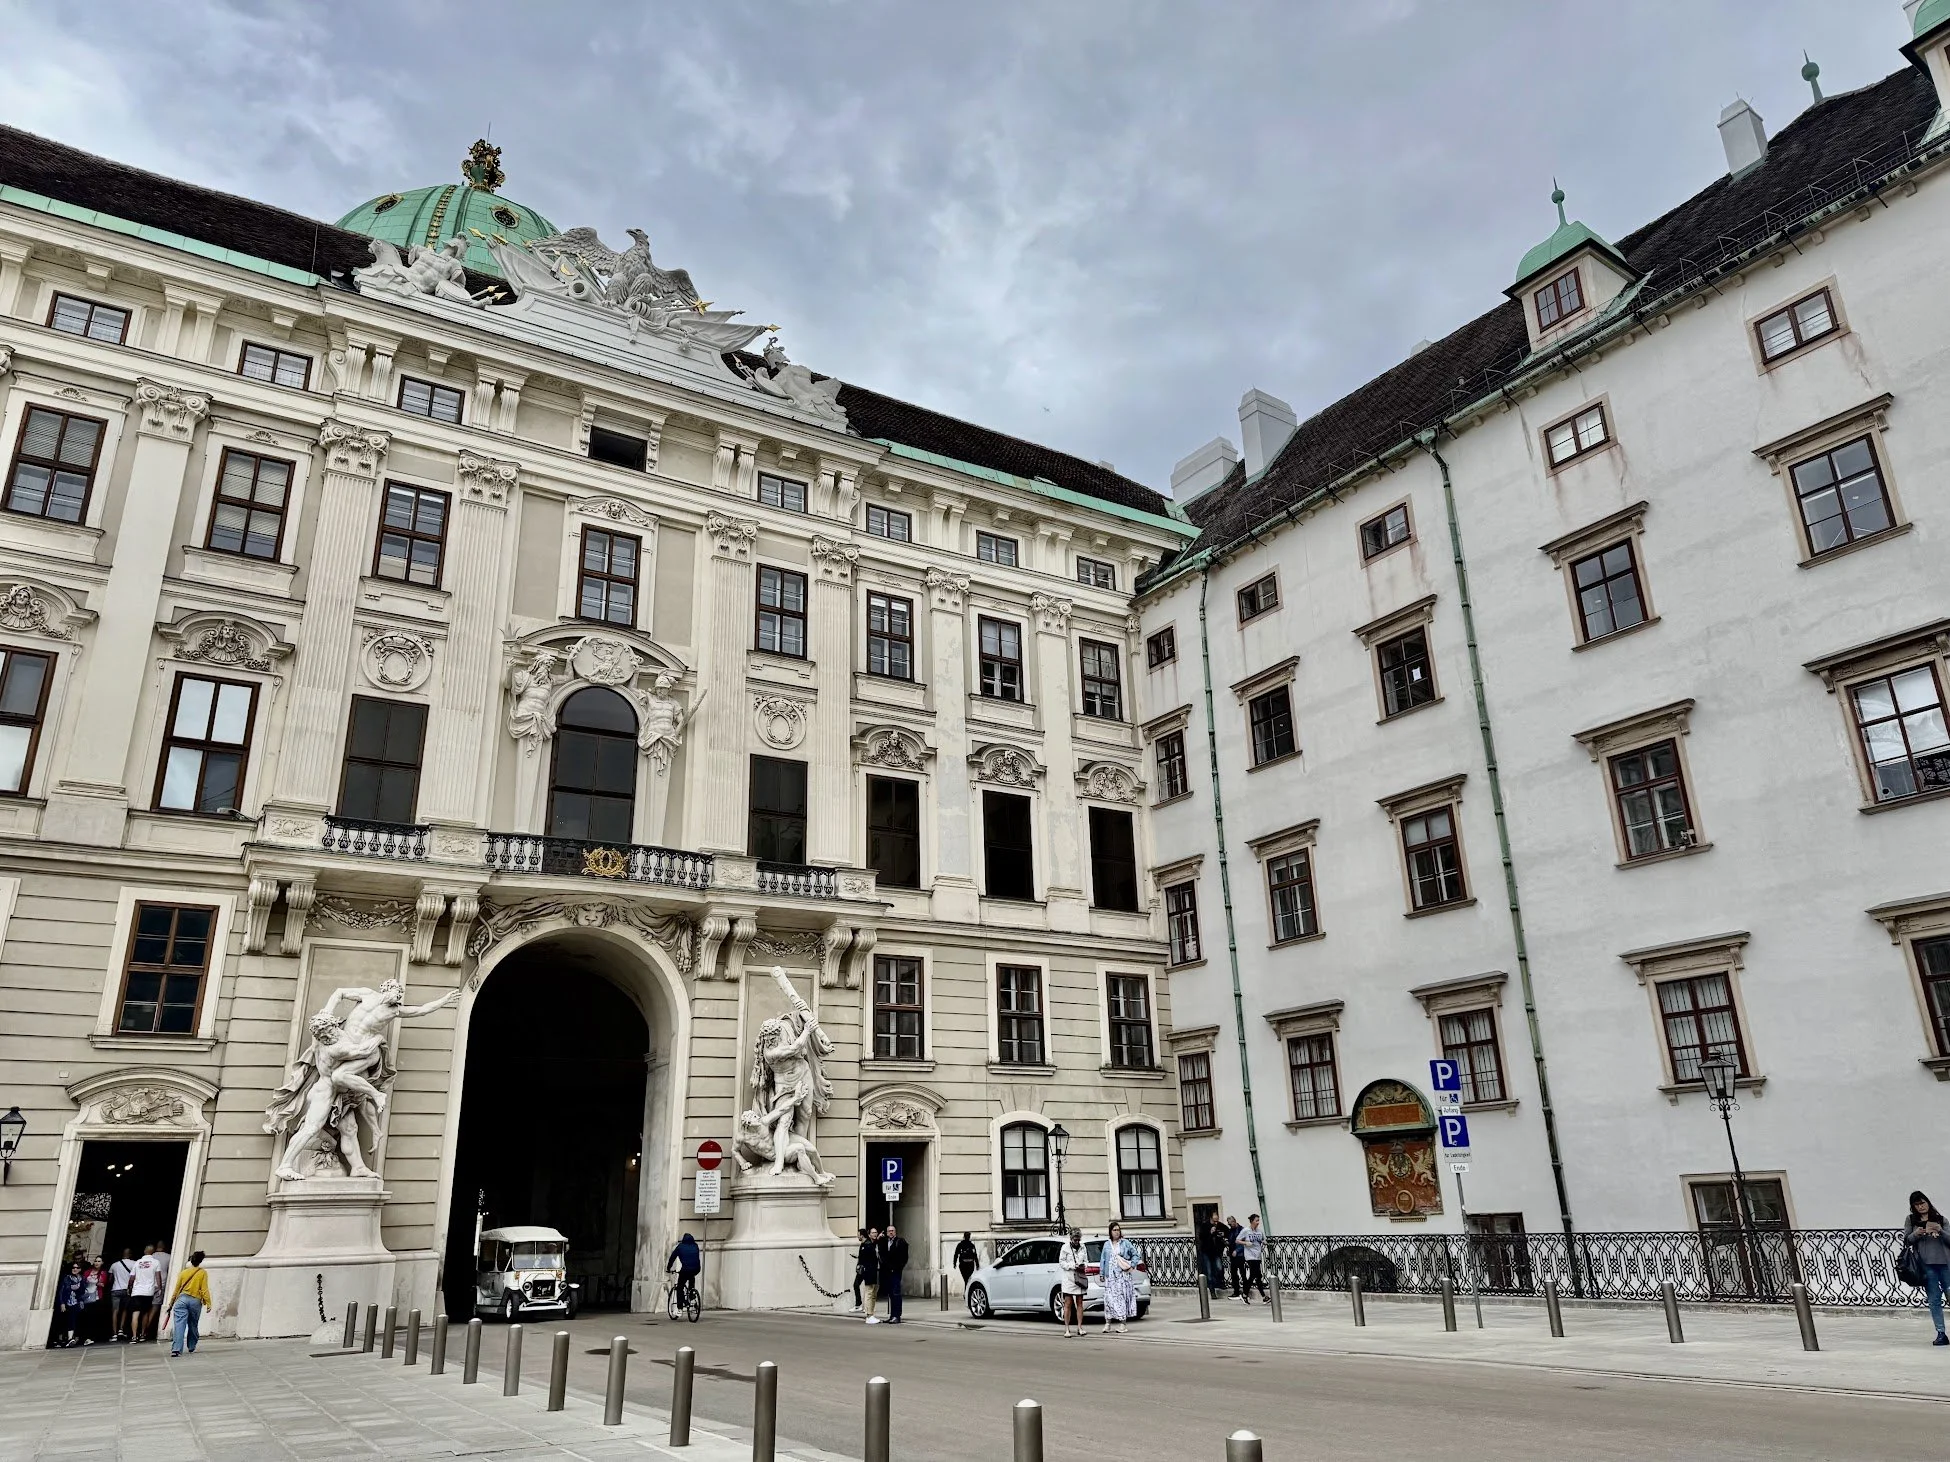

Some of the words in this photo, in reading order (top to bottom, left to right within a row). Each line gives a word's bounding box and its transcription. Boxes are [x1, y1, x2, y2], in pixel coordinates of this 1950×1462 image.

[1436, 1062, 1453, 1088] P
[1444, 1118, 1462, 1145] P
[886, 1160, 898, 1180] P
